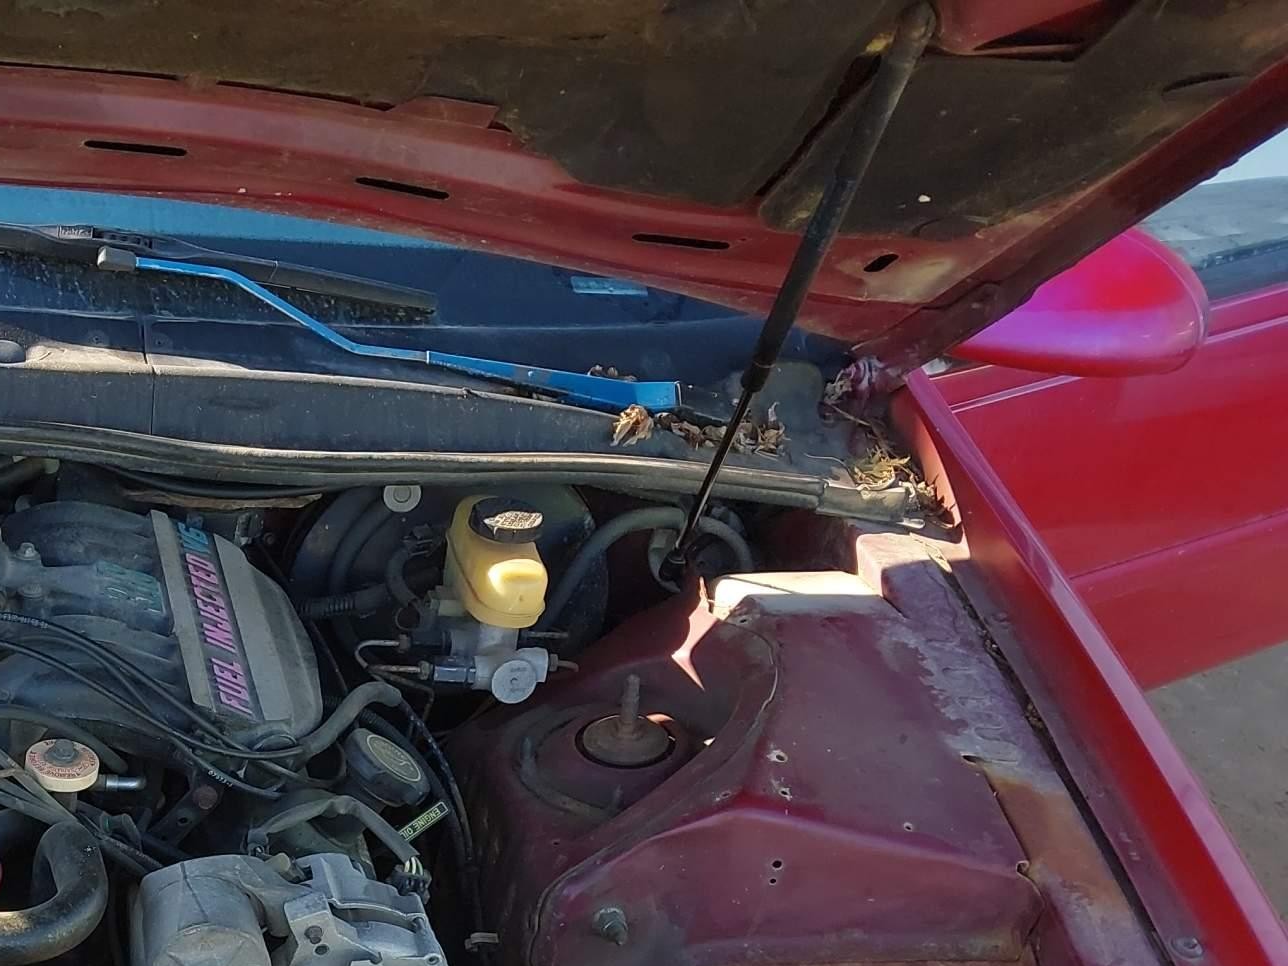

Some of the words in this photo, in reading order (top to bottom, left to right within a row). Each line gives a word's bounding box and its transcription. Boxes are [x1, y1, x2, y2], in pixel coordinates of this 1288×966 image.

[178, 521, 210, 553] V6
[186, 553, 239, 654] INJECTED
[211, 657, 256, 720] FUEL
[400, 828, 413, 840] OIL
[413, 808, 441, 831] ENGINE
